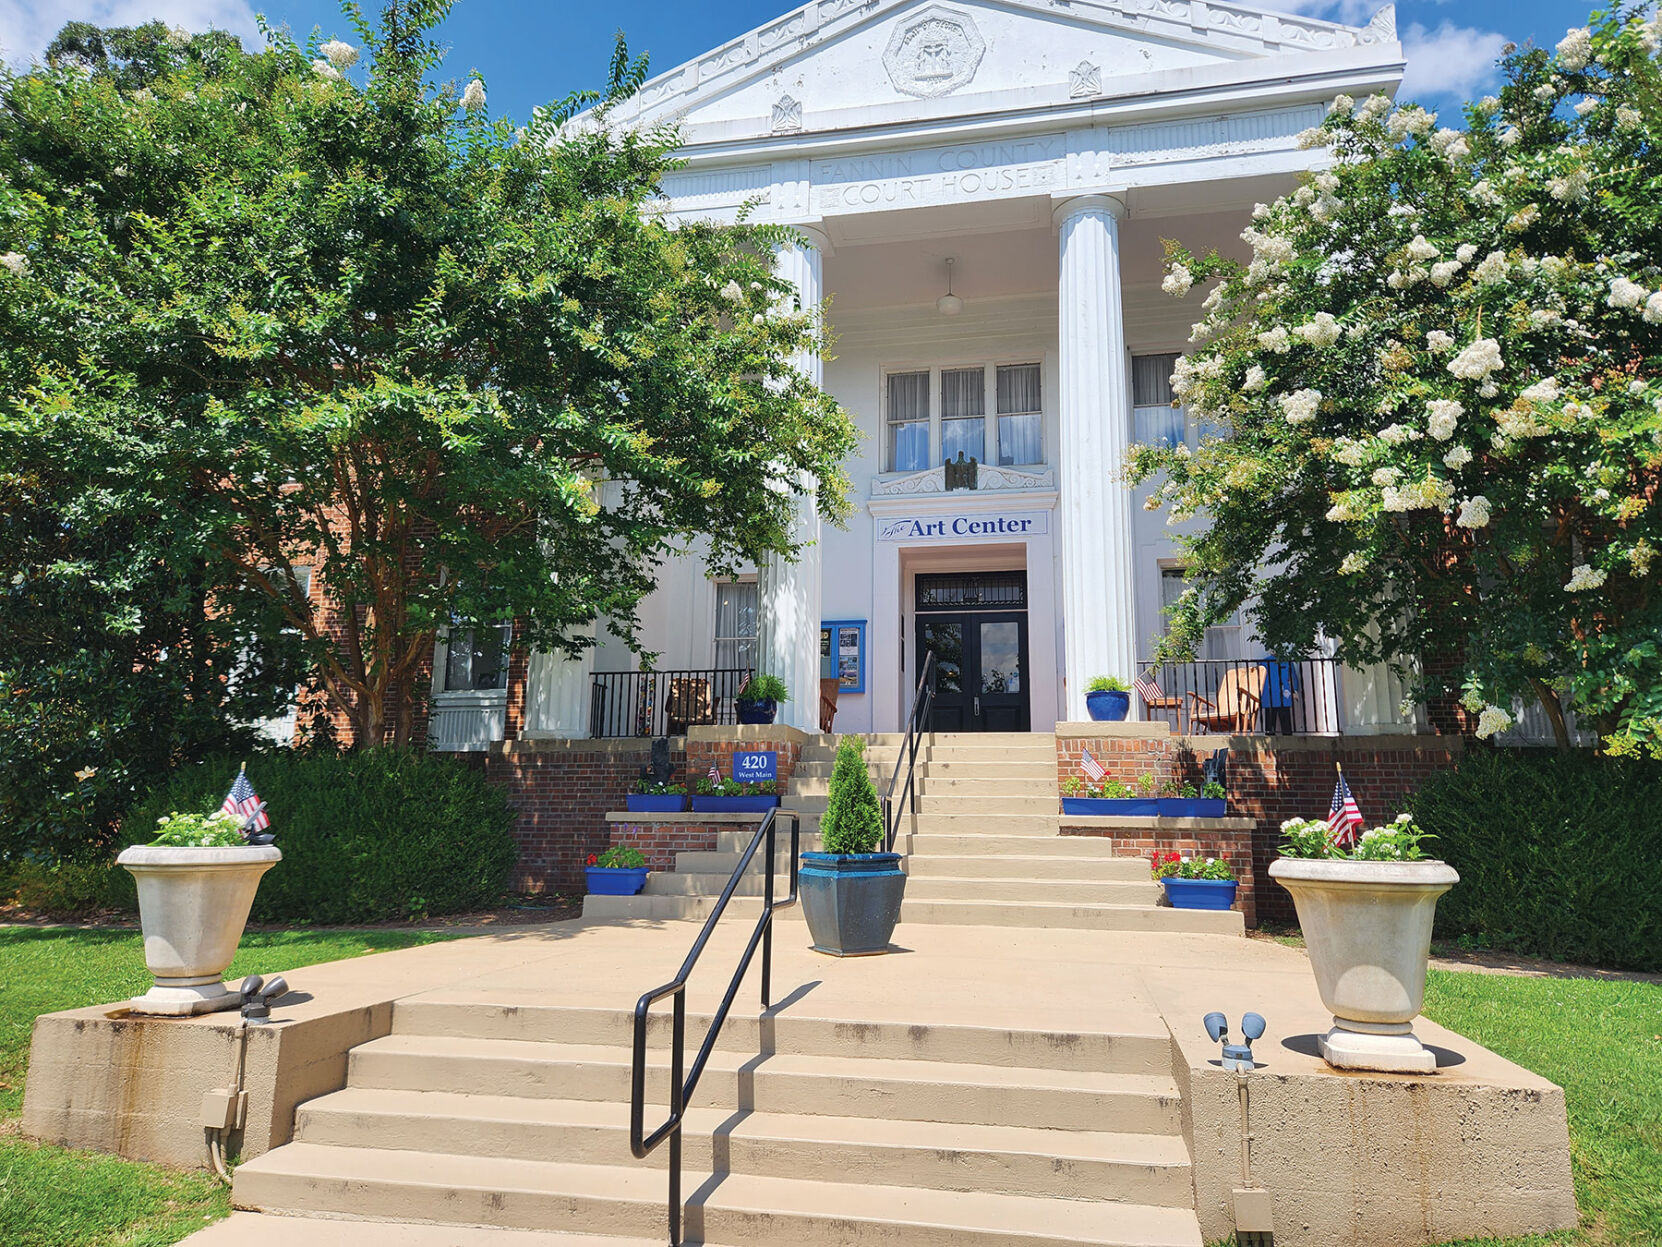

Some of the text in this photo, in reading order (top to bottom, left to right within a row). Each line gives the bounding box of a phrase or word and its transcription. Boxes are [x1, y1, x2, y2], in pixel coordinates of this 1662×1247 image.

[821, 140, 1054, 176] FANNIN COUNTY
[843, 168, 1031, 206] COURT HOUSE
[908, 519, 945, 537] Art
[952, 517, 1031, 535] Center
[742, 755, 767, 769] 420
